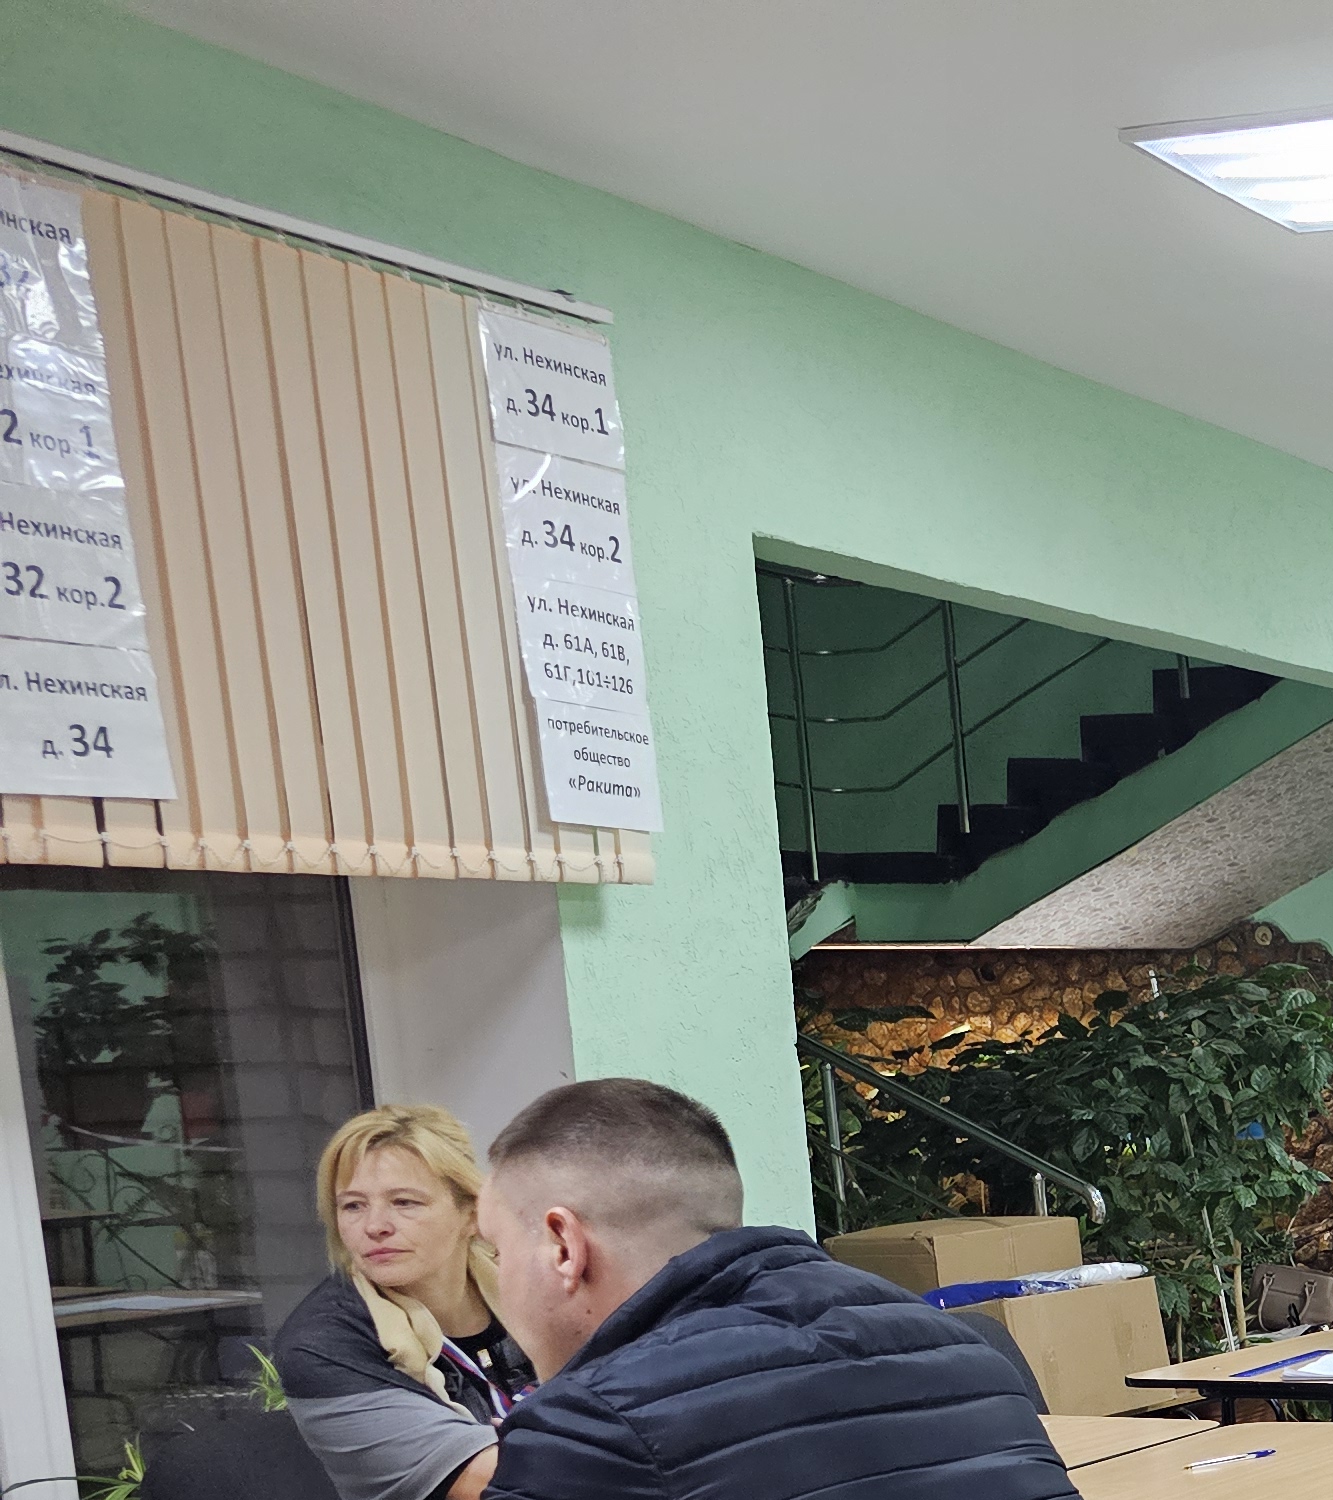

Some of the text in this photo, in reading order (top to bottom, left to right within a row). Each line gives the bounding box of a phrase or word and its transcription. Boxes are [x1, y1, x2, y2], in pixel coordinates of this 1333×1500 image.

[492, 341, 607, 387] ул. Нехинская
[506, 397, 522, 414] д.
[524, 388, 556, 422] 34
[541, 478, 621, 516] Нехинская
[0, 511, 123, 550] Нехинская
[521, 529, 539, 549] д.
[542, 519, 576, 552] 34
[2, 562, 49, 600] 32
[527, 594, 635, 632] ул. Нехинская
[543, 633, 559, 651] д.
[563, 633, 598, 659] 61А,
[25, 671, 149, 702] Нехинская
[41, 723, 115, 760] д. 34
[547, 716, 650, 746] потребительское
[573, 747, 631, 768] общество
[568, 774, 641, 799] «Ракита»
